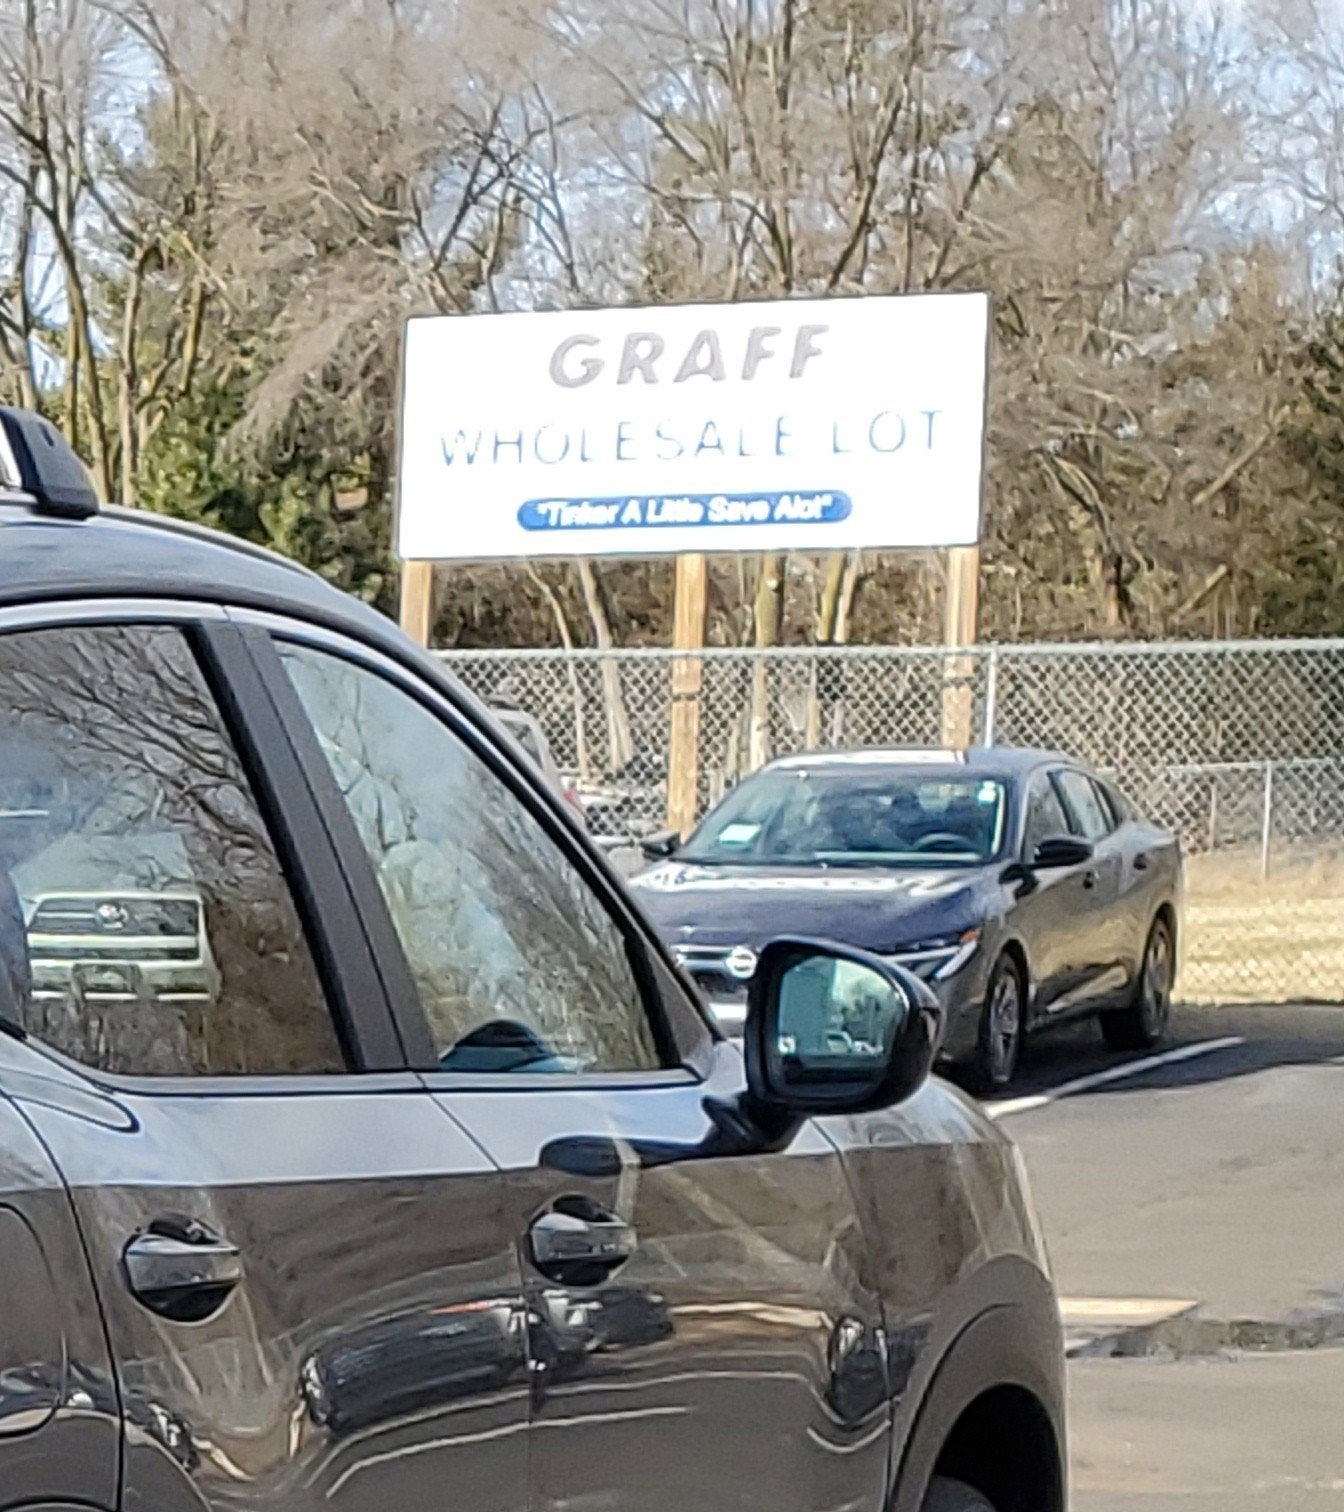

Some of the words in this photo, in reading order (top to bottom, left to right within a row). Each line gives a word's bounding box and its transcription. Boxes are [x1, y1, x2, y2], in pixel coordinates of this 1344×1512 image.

[549, 324, 830, 388] GRAFF
[439, 414, 794, 466] WHOLESALE
[831, 409, 944, 454] LOT
[620, 498, 643, 525] A
